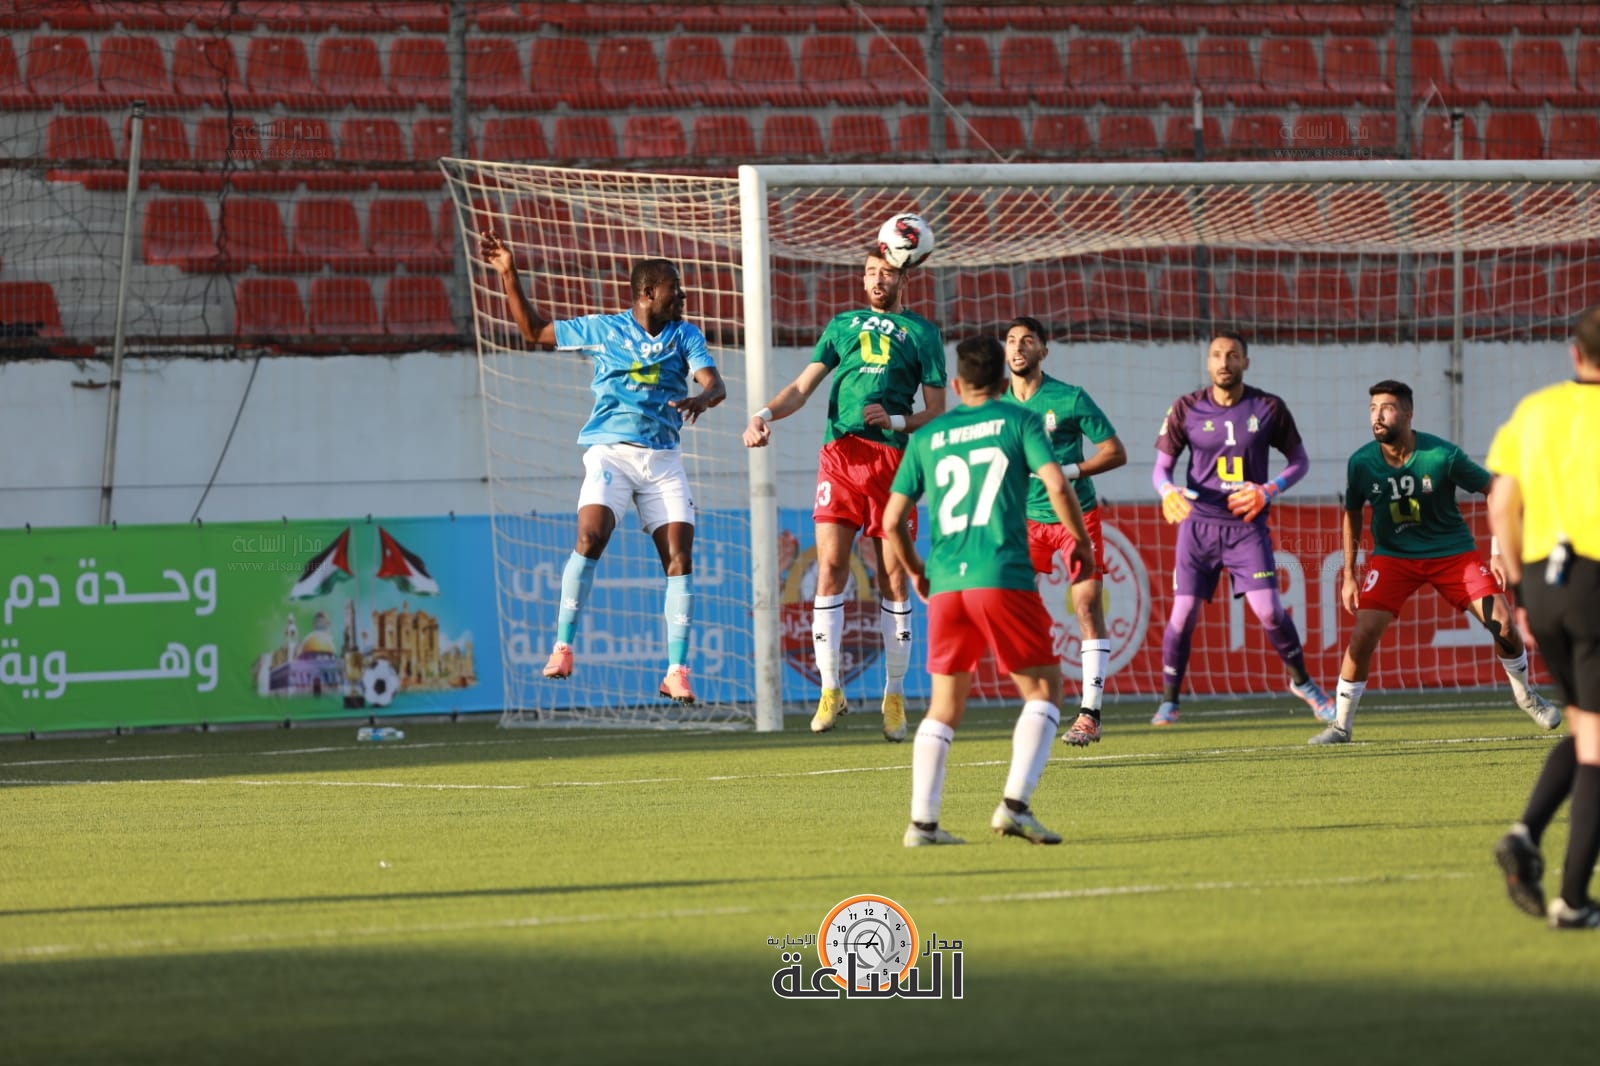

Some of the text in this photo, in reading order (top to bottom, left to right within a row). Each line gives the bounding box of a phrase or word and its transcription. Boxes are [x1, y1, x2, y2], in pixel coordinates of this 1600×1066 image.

[1224, 421, 1236, 446] 1
[935, 447, 1009, 536] 27
[1388, 475, 1414, 500] 19
[4, 558, 217, 625] وحدة دم
[0, 638, 219, 699] وهوية
